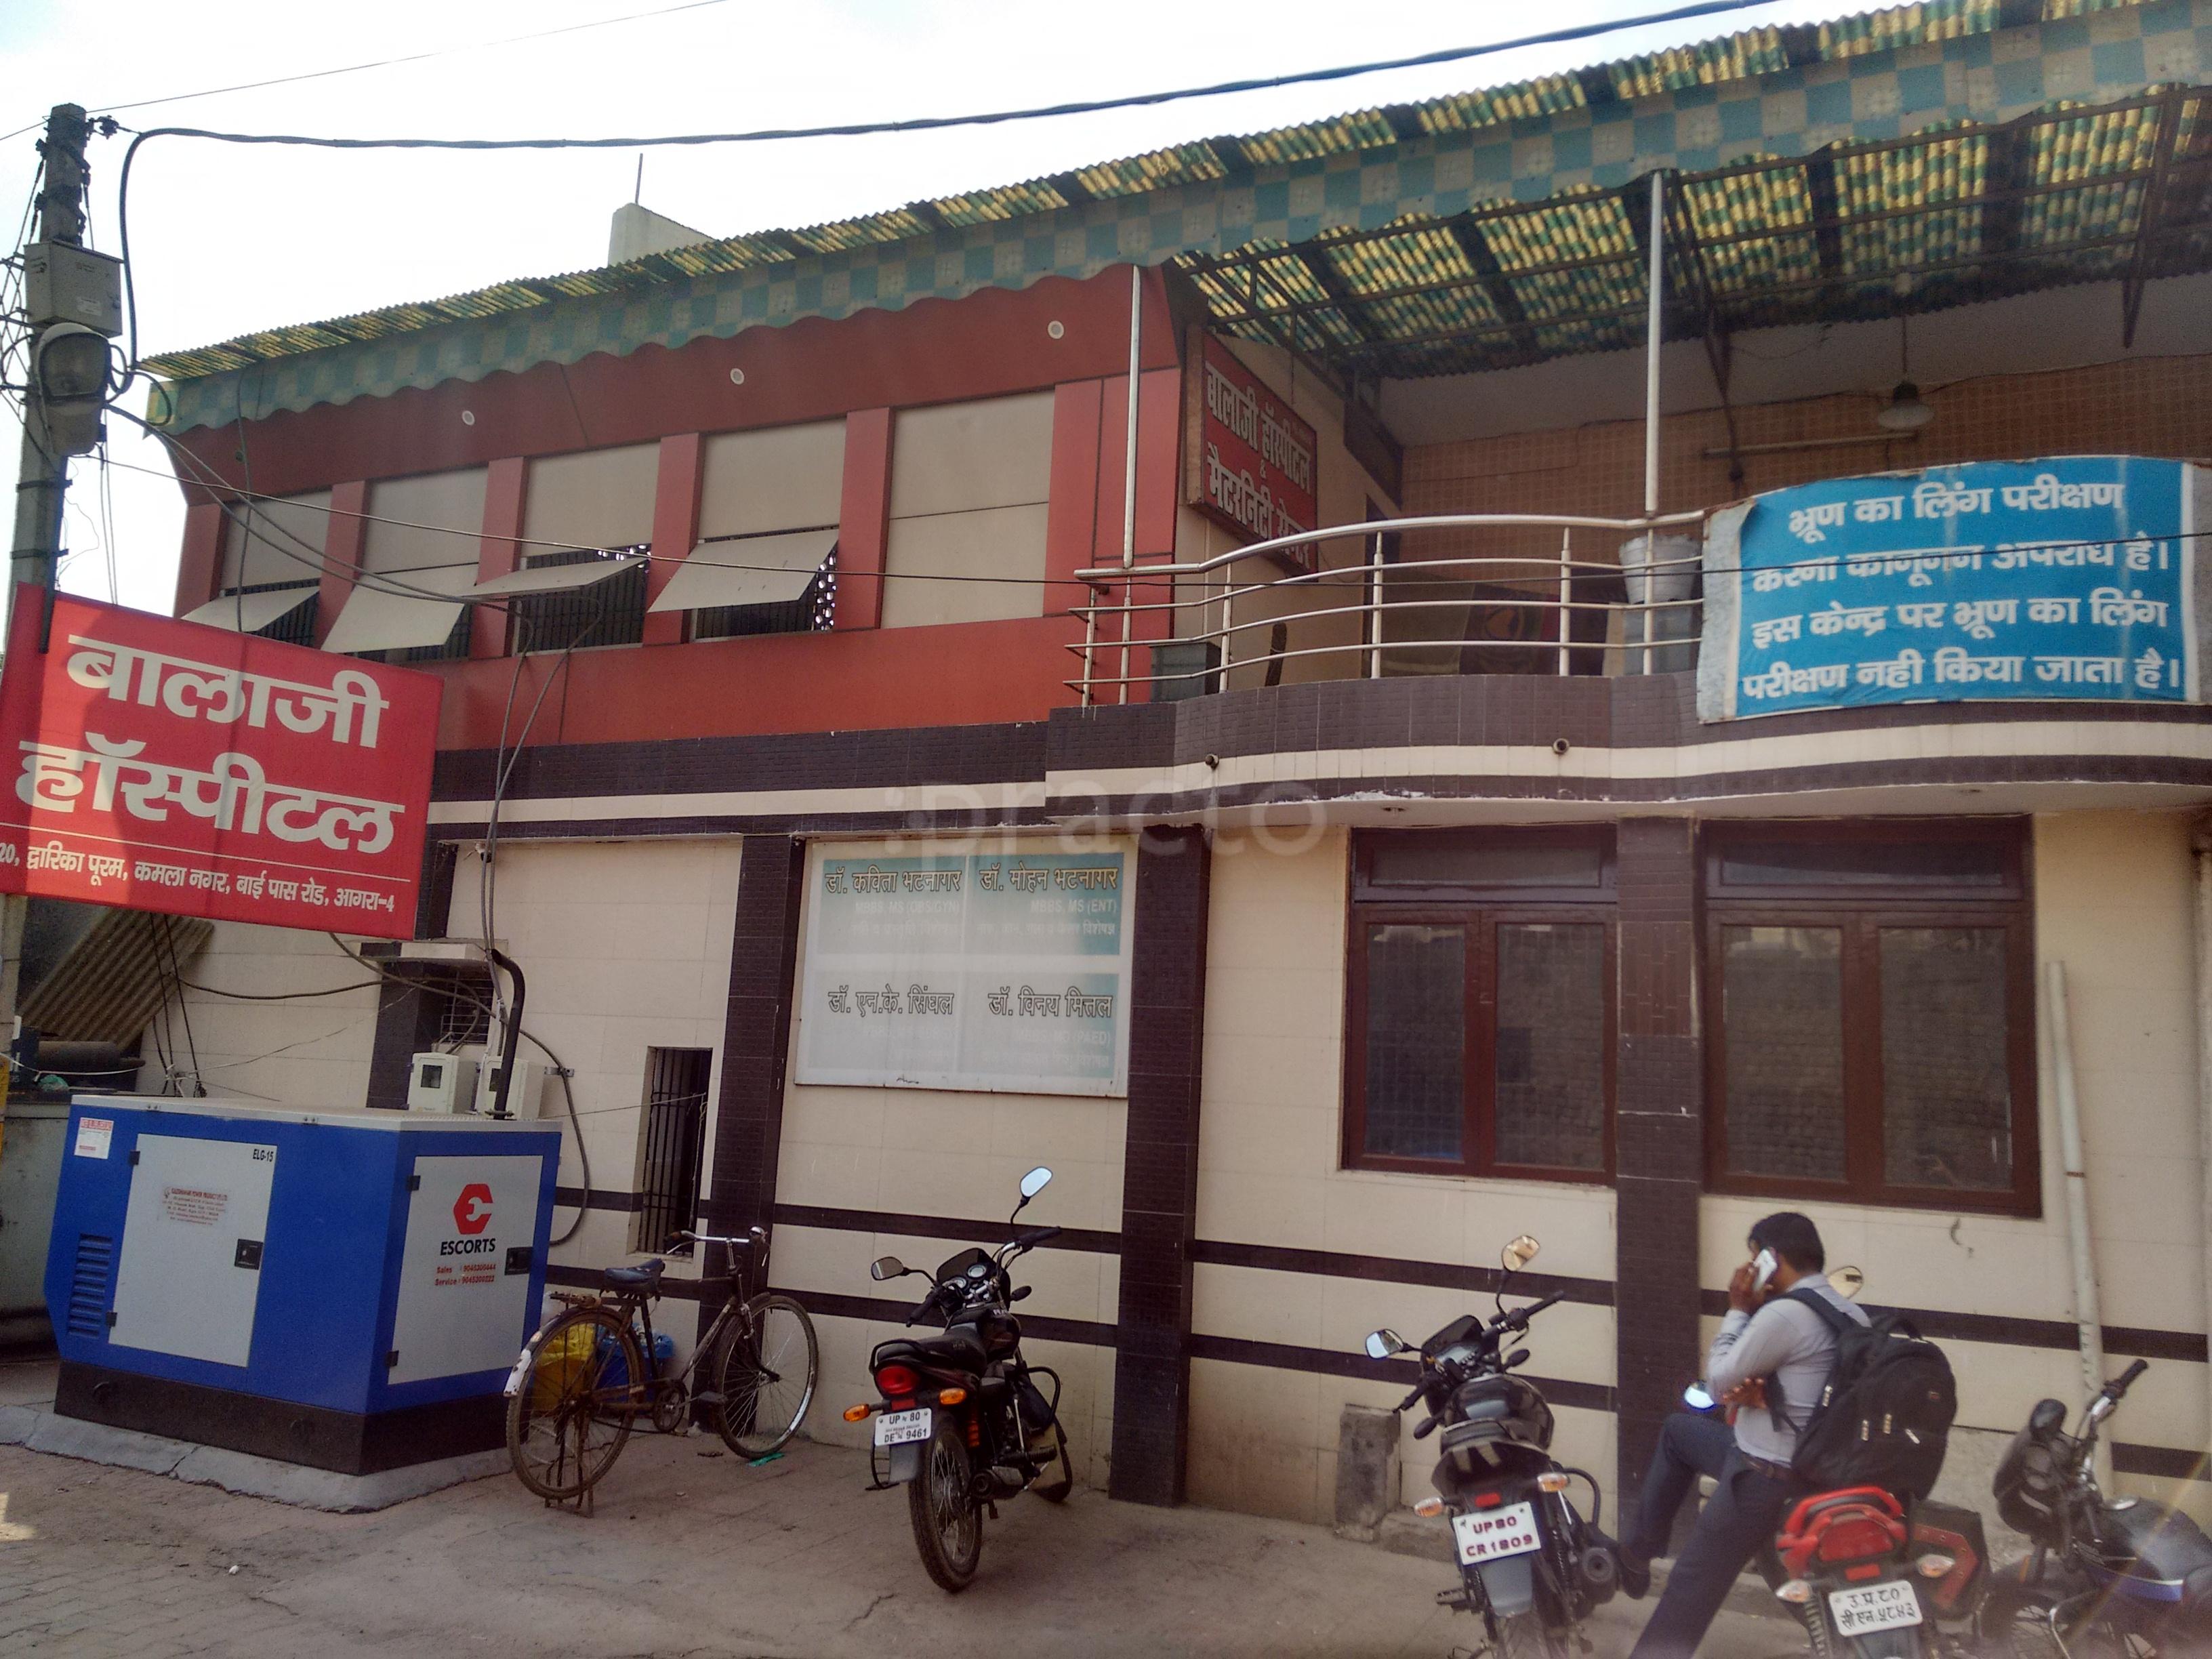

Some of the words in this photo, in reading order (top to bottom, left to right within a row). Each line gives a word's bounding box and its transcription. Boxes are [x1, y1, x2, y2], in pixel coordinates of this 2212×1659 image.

[1788, 499, 1847, 544] भ्रूण
[1853, 495, 1905, 523] का
[1912, 481, 1994, 519] लिंग
[2002, 473, 2126, 513] परीक्षण
[1752, 555, 1840, 592] करना
[1845, 544, 1986, 587] कानूनन
[1991, 539, 2116, 569] अपराध
[1751, 614, 1803, 650] इस
[1809, 600, 1889, 637] केन्द्र
[1896, 602, 1948, 628] पर
[1953, 599, 2018, 640] भ्रूण
[2027, 596, 2082, 623] का
[2089, 586, 2169, 628] लिंग
[1742, 661, 1849, 699] परीक्षण
[1856, 648, 1925, 689] नही
[1933, 646, 2025, 683] किया
[2034, 655, 2125, 685] जाता
[66, 634, 390, 750] बालाजी
[14, 731, 406, 855] हॉस्पीटल
[26, 840, 86, 873] द्वारिका
[88, 854, 129, 886] पूरम,
[135, 861, 186, 887] कमला
[189, 869, 231, 895] नगर,
[236, 870, 268, 900] बाई
[268, 878, 299, 901] पास
[301, 876, 330, 907] रोड,
[825, 866, 848, 894] डॉ.
[853, 865, 898, 893] कविता
[902, 869, 962, 893] भटनागर
[979, 863, 1004, 891] डॉ.
[1008, 861, 1048, 894] मोहन
[1053, 866, 1119, 890] भटनागर
[1068, 899, 1084, 913] MS
[1087, 898, 1118, 916] (ENT)
[828, 985, 851, 1014] डॉ.
[908, 984, 954, 1015] सिंघल
[988, 986, 1013, 1017] डॉ.
[1018, 985, 1061, 1017] विनय
[1065, 986, 1113, 1018] मित्तल
[253, 1148, 274, 1162] ELG-15
[441, 1238, 496, 1256] ESCORTS
[434, 1278, 457, 1286] Service
[437, 1265, 452, 1274] Sales
[889, 1416, 900, 1425] UP
[909, 1412, 920, 1422] 80
[906, 1428, 927, 1439] 9461
